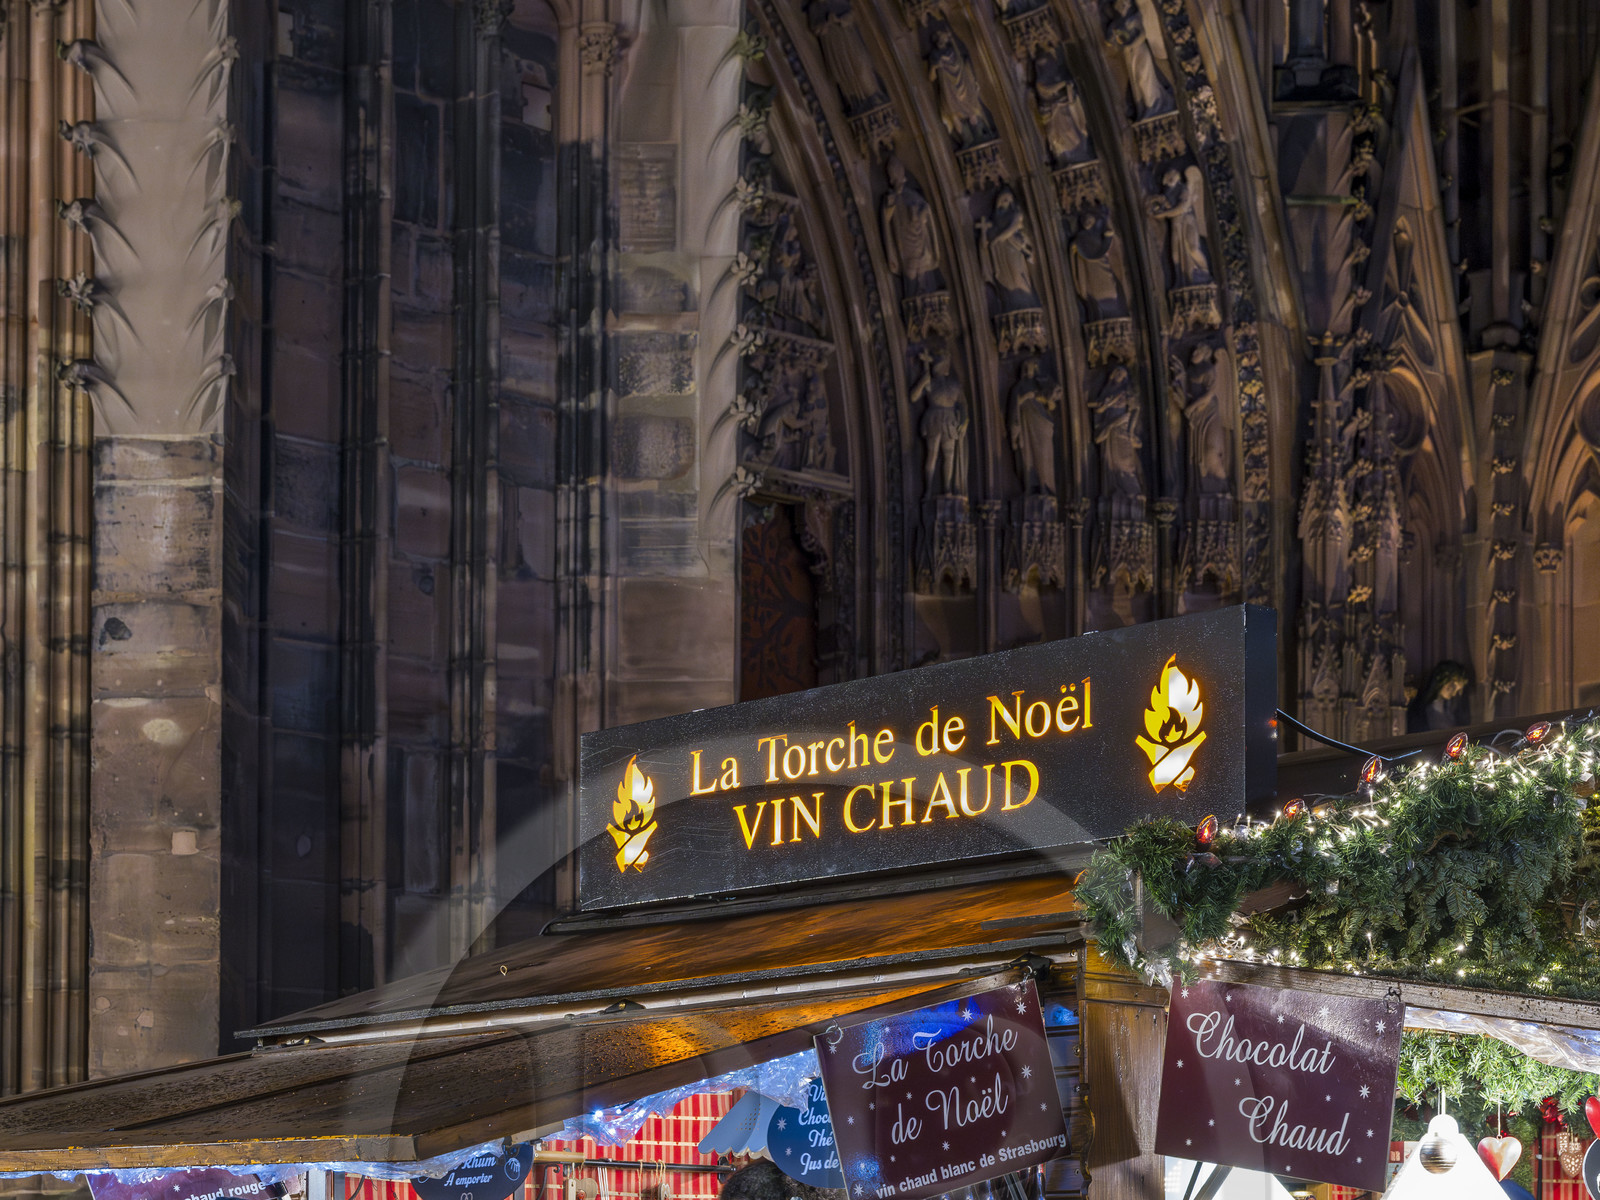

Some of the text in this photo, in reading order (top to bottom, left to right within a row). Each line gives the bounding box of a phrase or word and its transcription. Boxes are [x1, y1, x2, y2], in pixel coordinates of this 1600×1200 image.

[690, 676, 1093, 796] La Torche de Noël
[733, 760, 1040, 850] VIN CHAUD
[852, 1013, 1018, 1090] La Torche
[1186, 1010, 1336, 1074] Chocolat
[808, 1129, 834, 1148] Thé
[891, 1072, 1009, 1145] de Noël
[1238, 1095, 1350, 1156] Chaud
[229, 1181, 267, 1198] rouge
[455, 1173, 493, 1188] emporter
[800, 1151, 840, 1176] Jus de
[875, 1133, 1067, 1200] vin chaud blanc de Strasbourg
